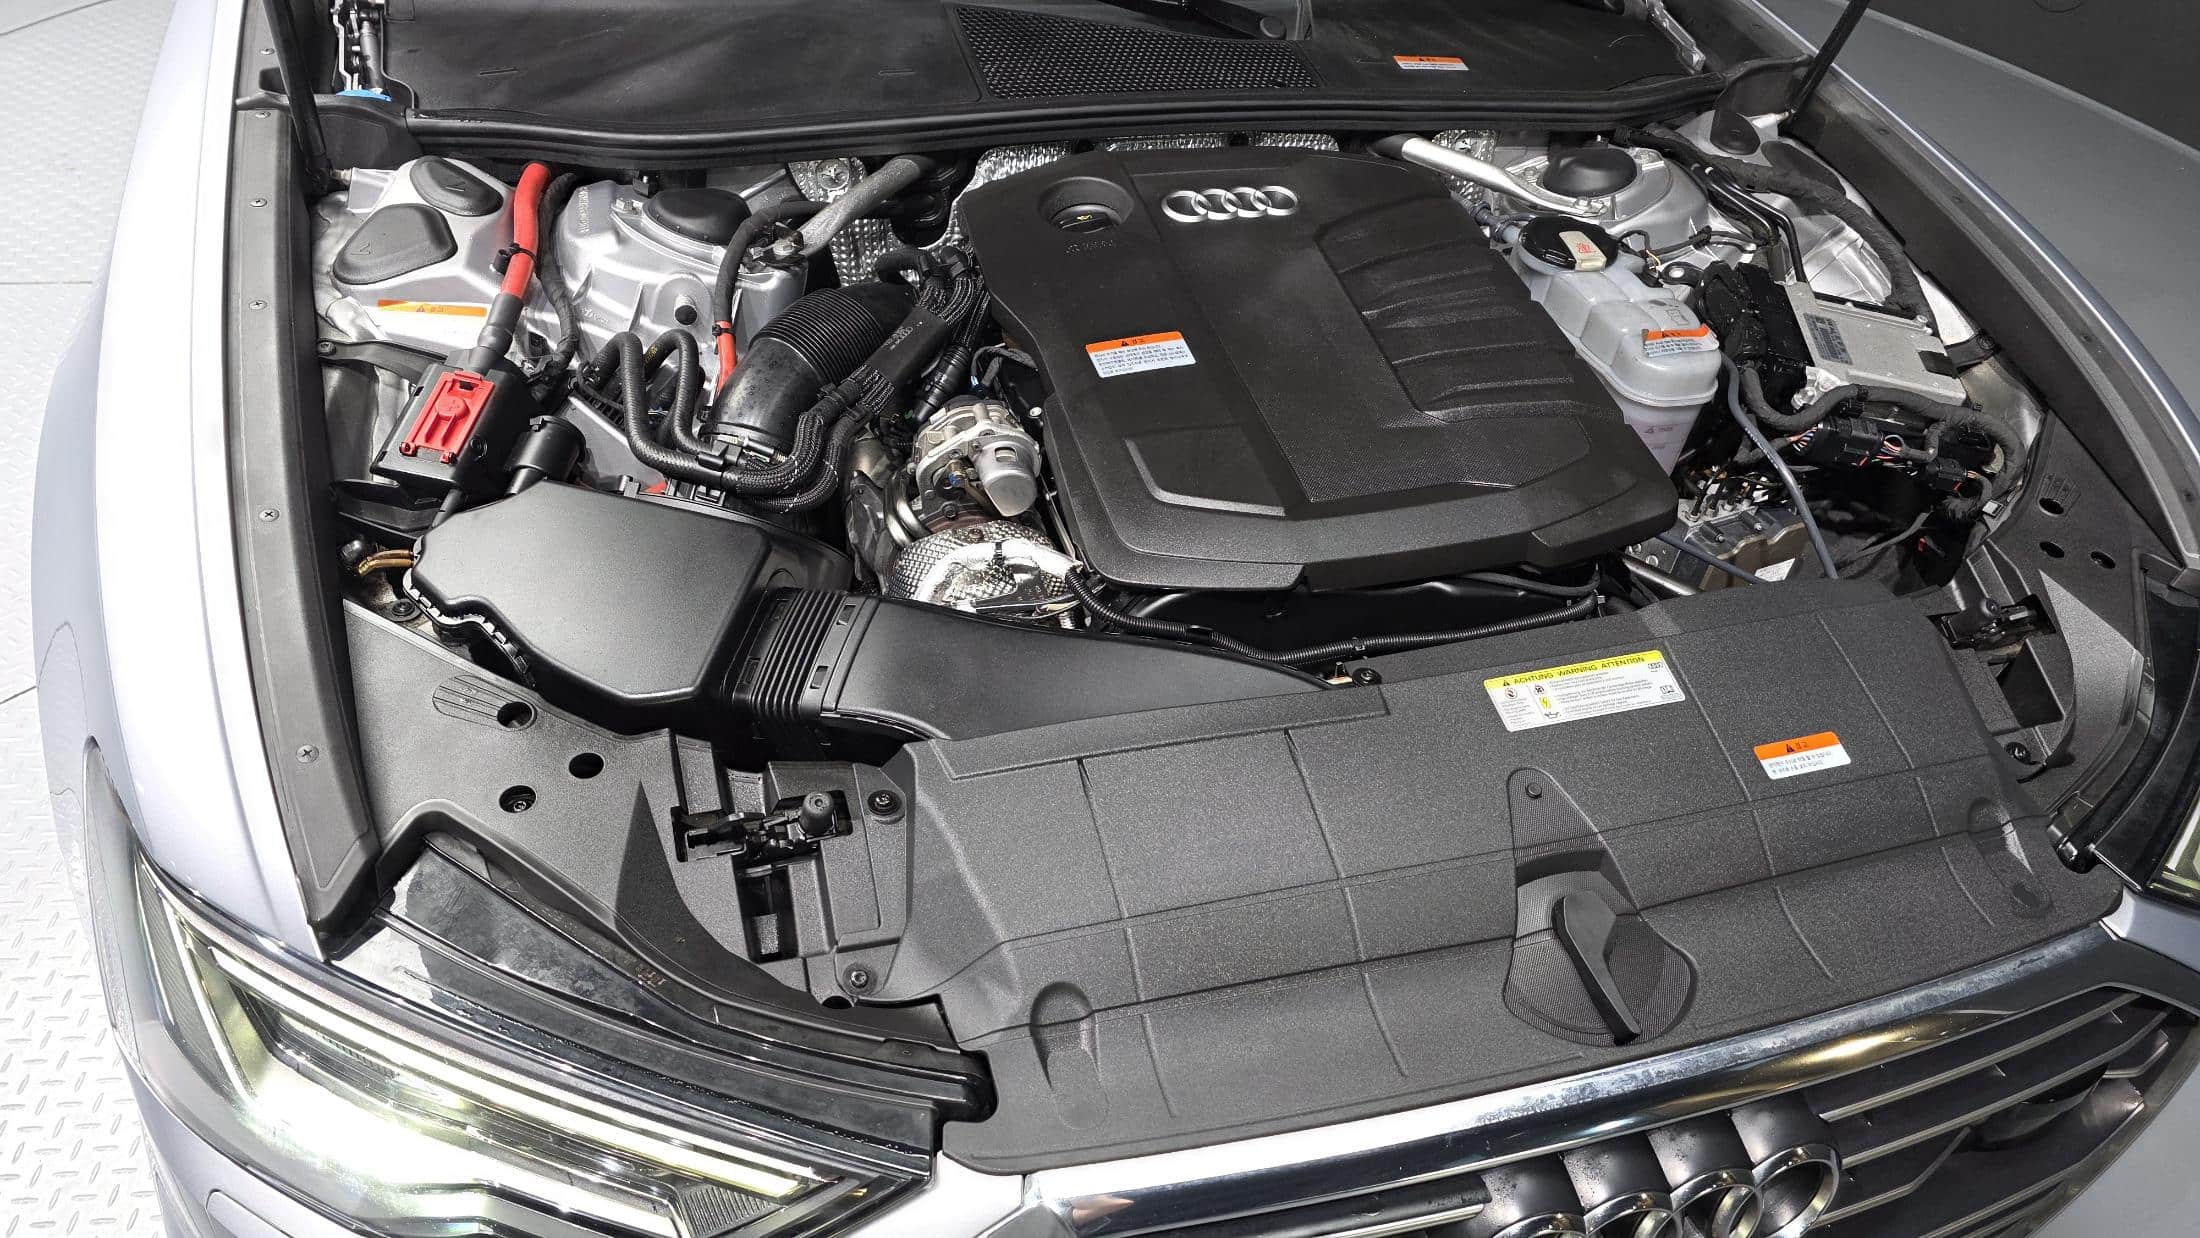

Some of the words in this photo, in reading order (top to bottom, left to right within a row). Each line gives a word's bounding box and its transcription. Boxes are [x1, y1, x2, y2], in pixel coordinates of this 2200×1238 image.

[1514, 672, 1554, 685] ACHTUNG
[1558, 664, 1598, 677] WARNING
[1601, 657, 1645, 669] ATTENTION
